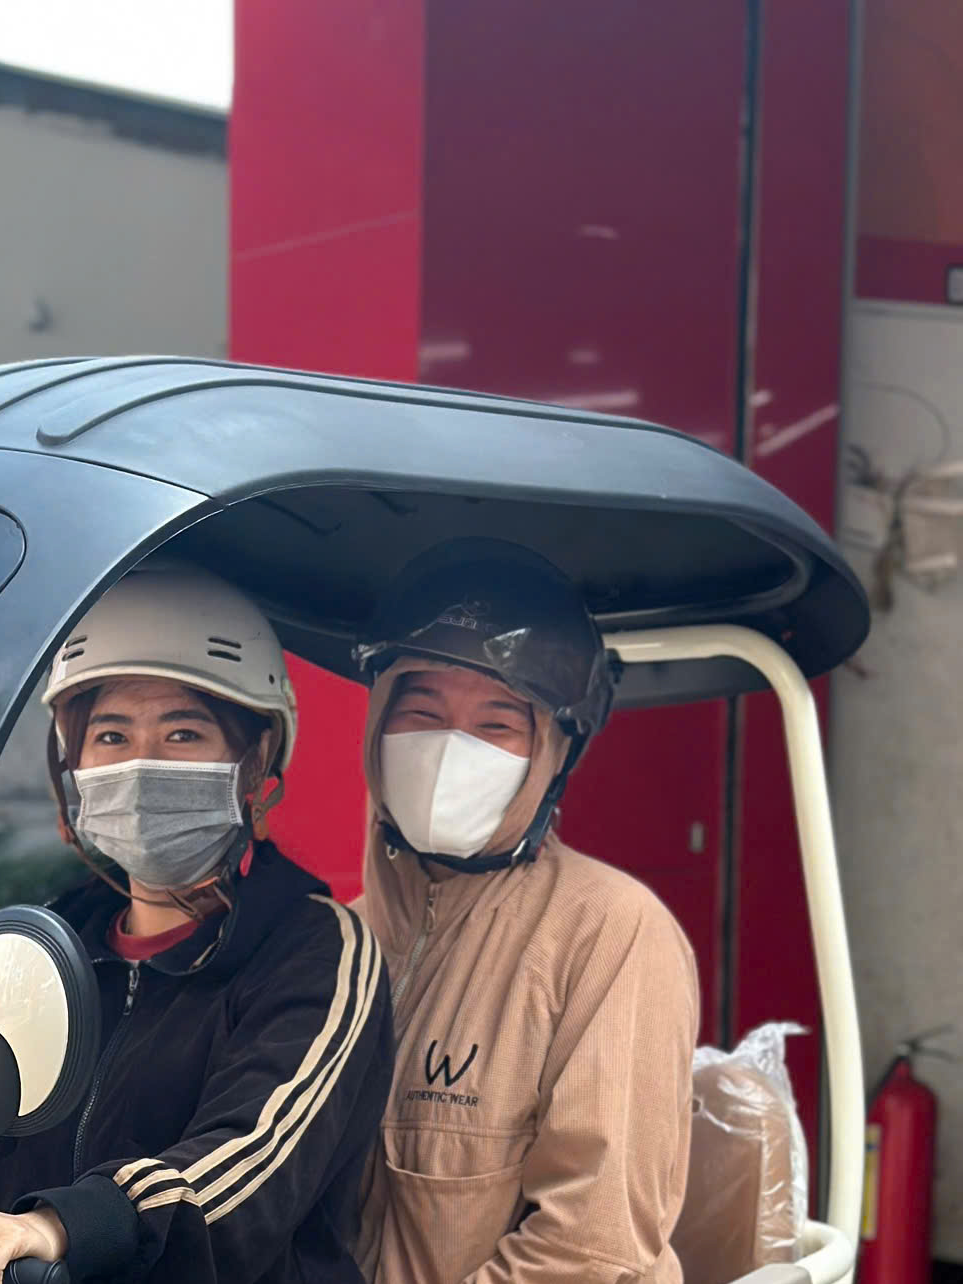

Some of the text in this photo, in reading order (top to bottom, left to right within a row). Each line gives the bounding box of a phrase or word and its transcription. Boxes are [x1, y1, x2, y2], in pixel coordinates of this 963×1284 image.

[425, 1039, 479, 1087] W
[406, 1090, 479, 1107] AUTHENTIC WEAR
